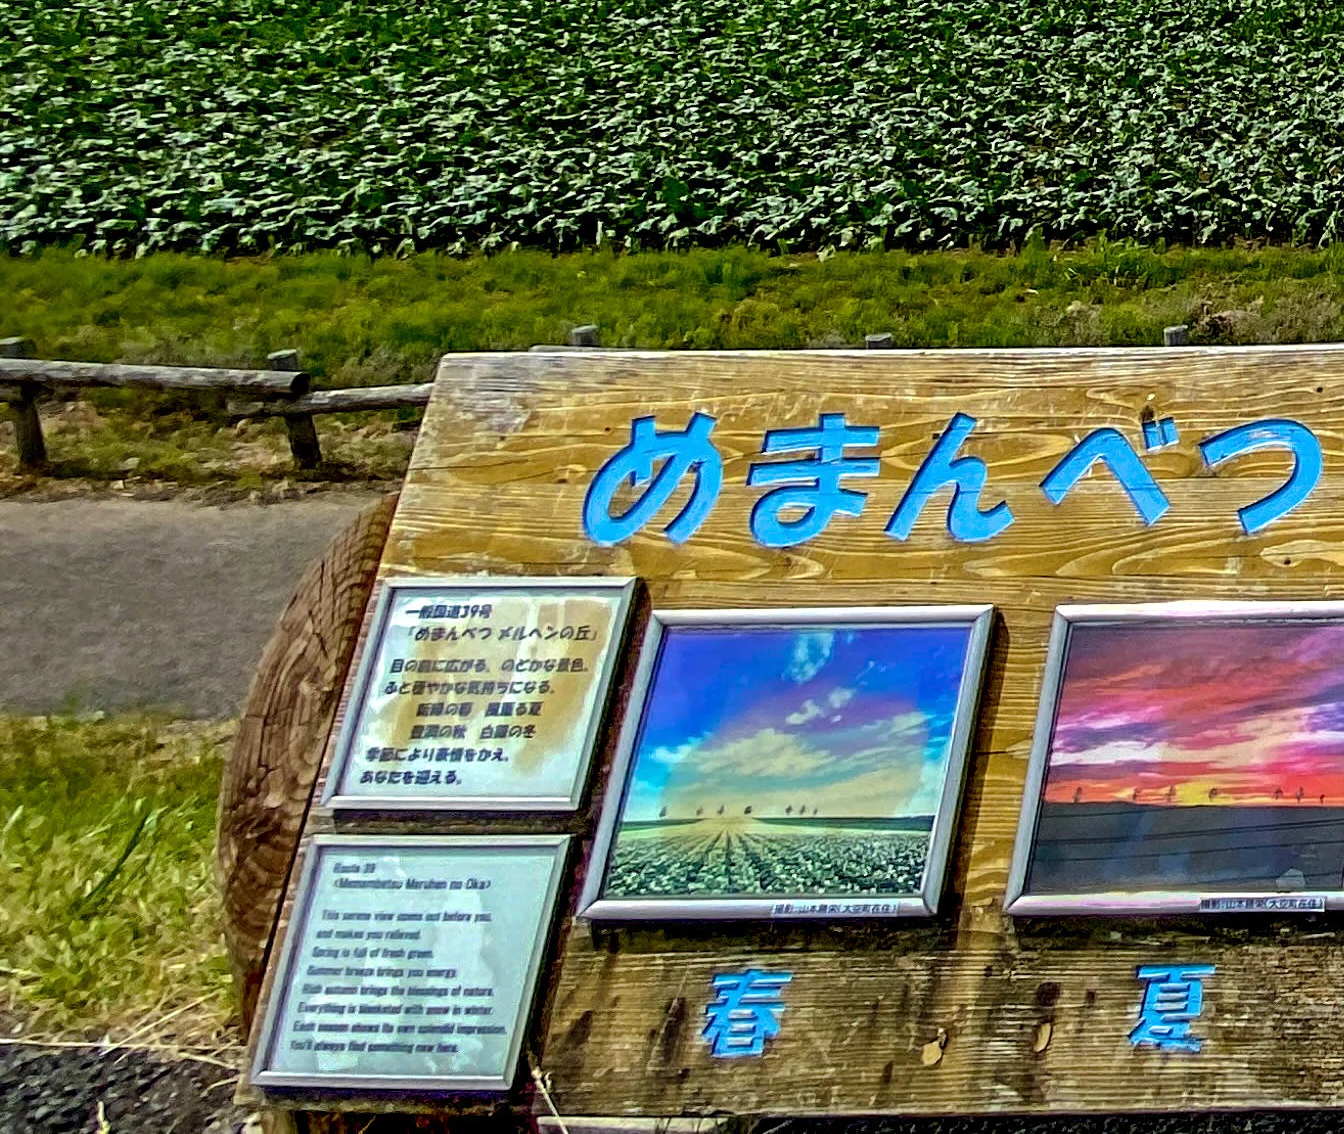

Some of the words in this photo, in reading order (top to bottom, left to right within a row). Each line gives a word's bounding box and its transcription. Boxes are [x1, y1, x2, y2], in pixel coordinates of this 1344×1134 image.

[582, 411, 1323, 548] めまんべつ
[701, 967, 793, 1059] 春
[1128, 963, 1217, 1053] 夏
